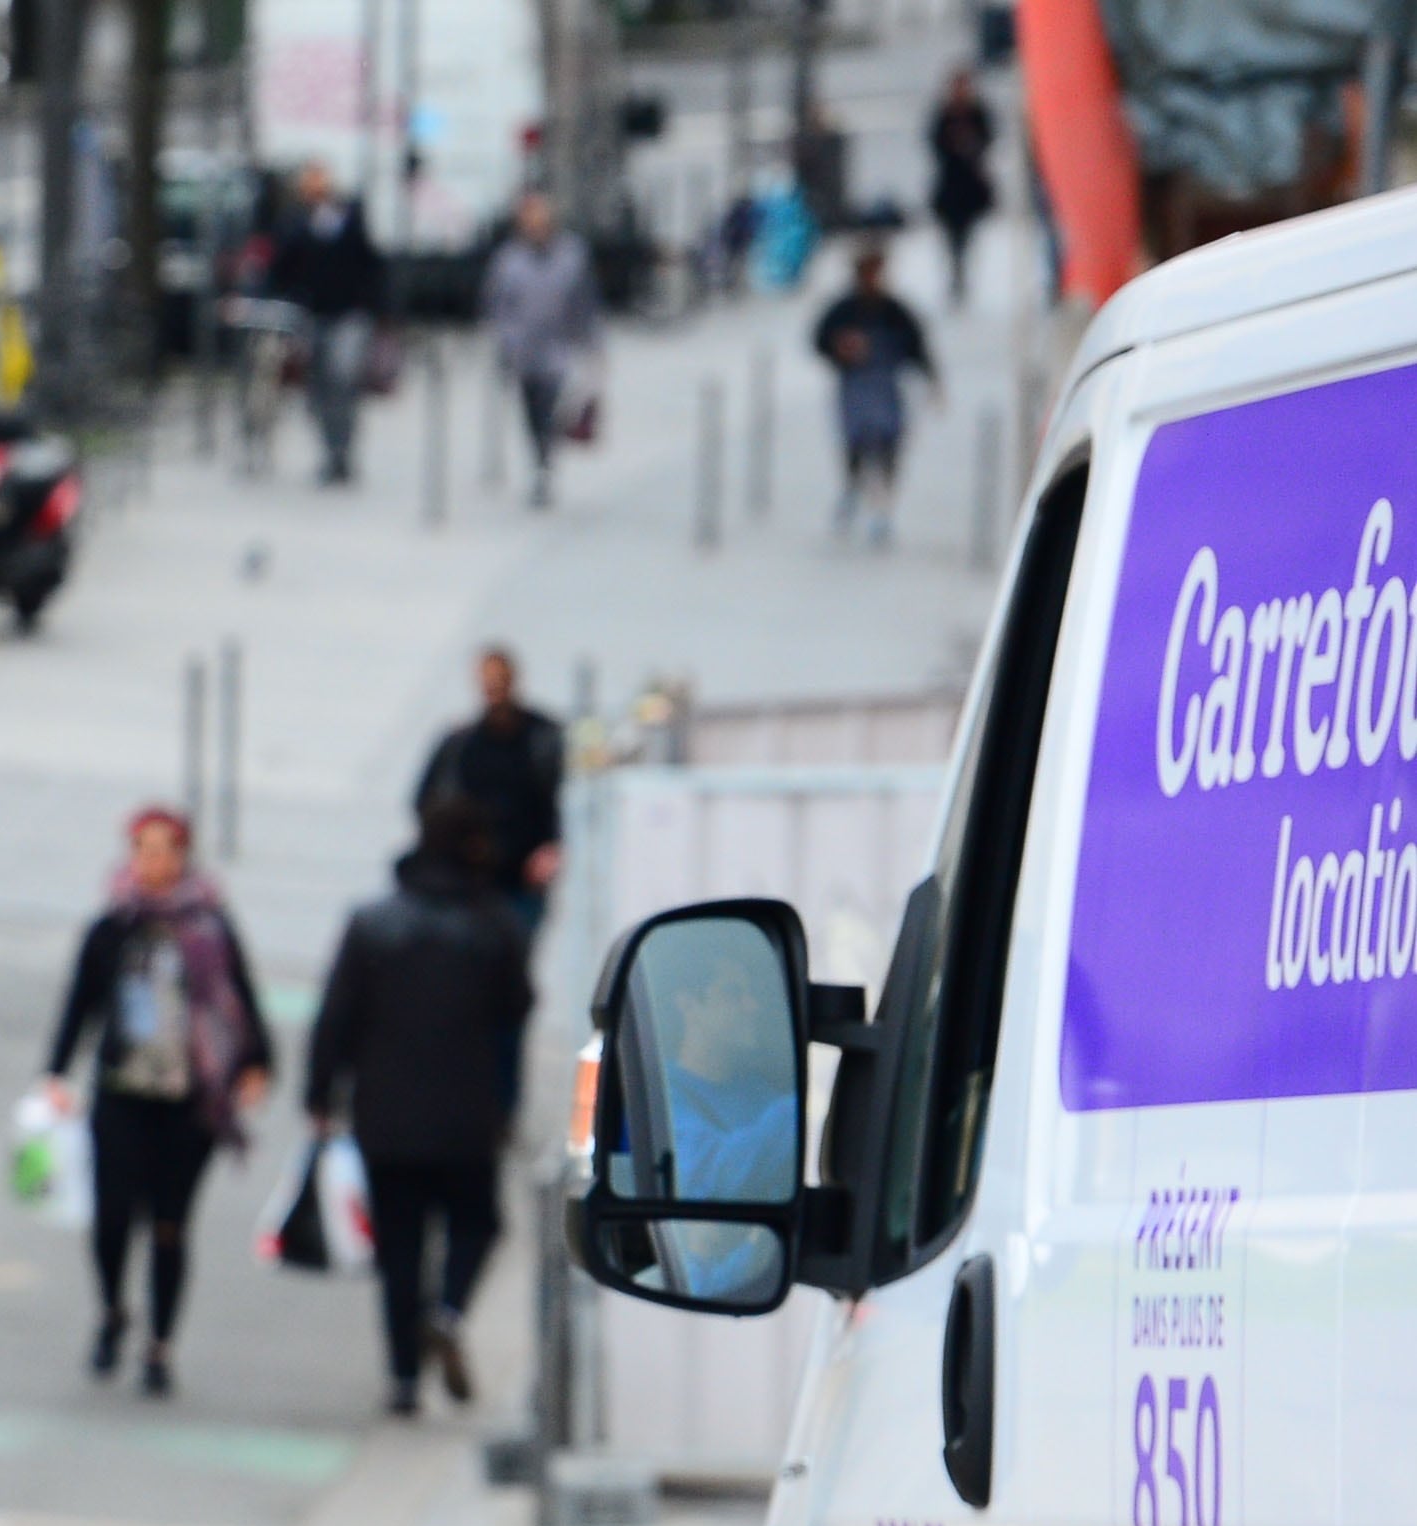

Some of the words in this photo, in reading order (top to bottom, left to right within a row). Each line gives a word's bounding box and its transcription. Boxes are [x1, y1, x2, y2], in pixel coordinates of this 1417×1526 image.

[1266, 798, 1417, 991] locatio
[1130, 1295, 1168, 1347] DANS
[1170, 1295, 1204, 1347] PLUS
[1206, 1295, 1225, 1347] DE
